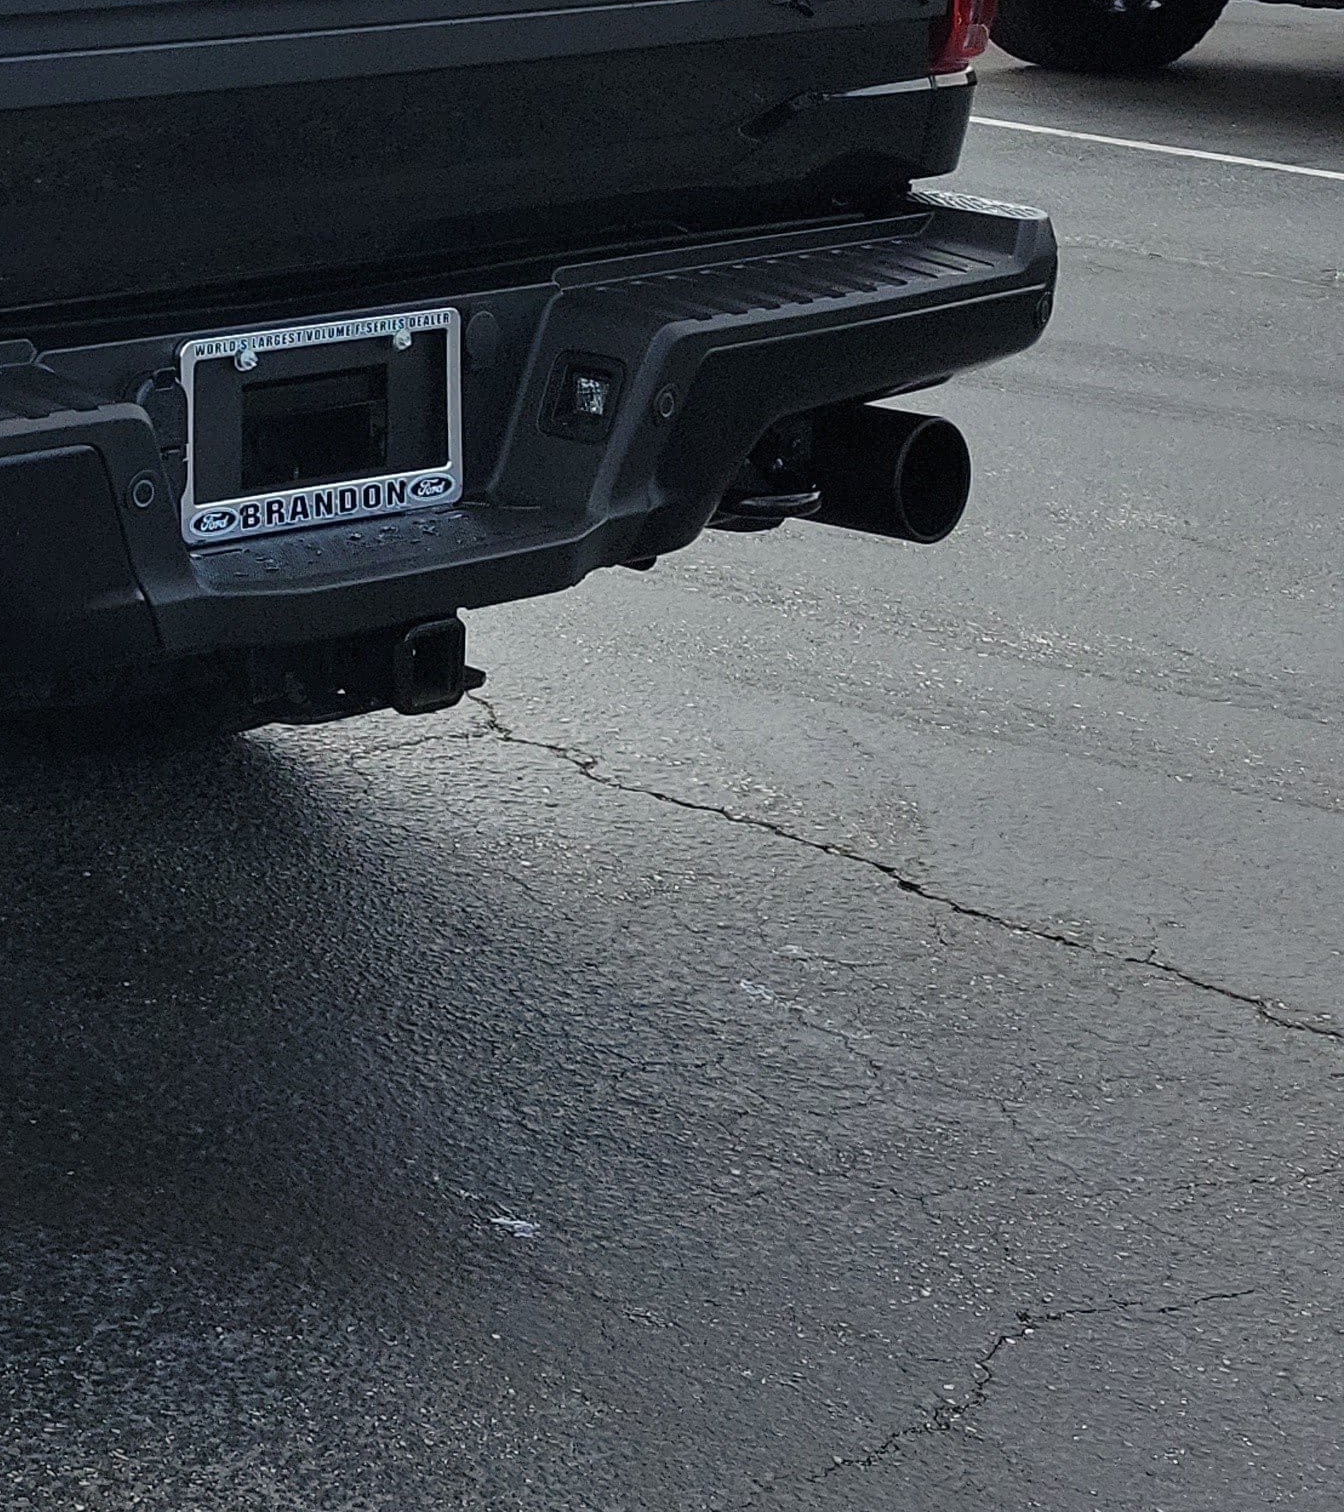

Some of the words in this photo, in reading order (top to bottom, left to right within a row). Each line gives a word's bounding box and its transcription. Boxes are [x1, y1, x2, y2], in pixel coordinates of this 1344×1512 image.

[252, 331, 302, 349] LARGEST
[305, 324, 351, 342] VOLUME
[408, 311, 451, 329] DEALER
[238, 478, 409, 531] BRANDON
